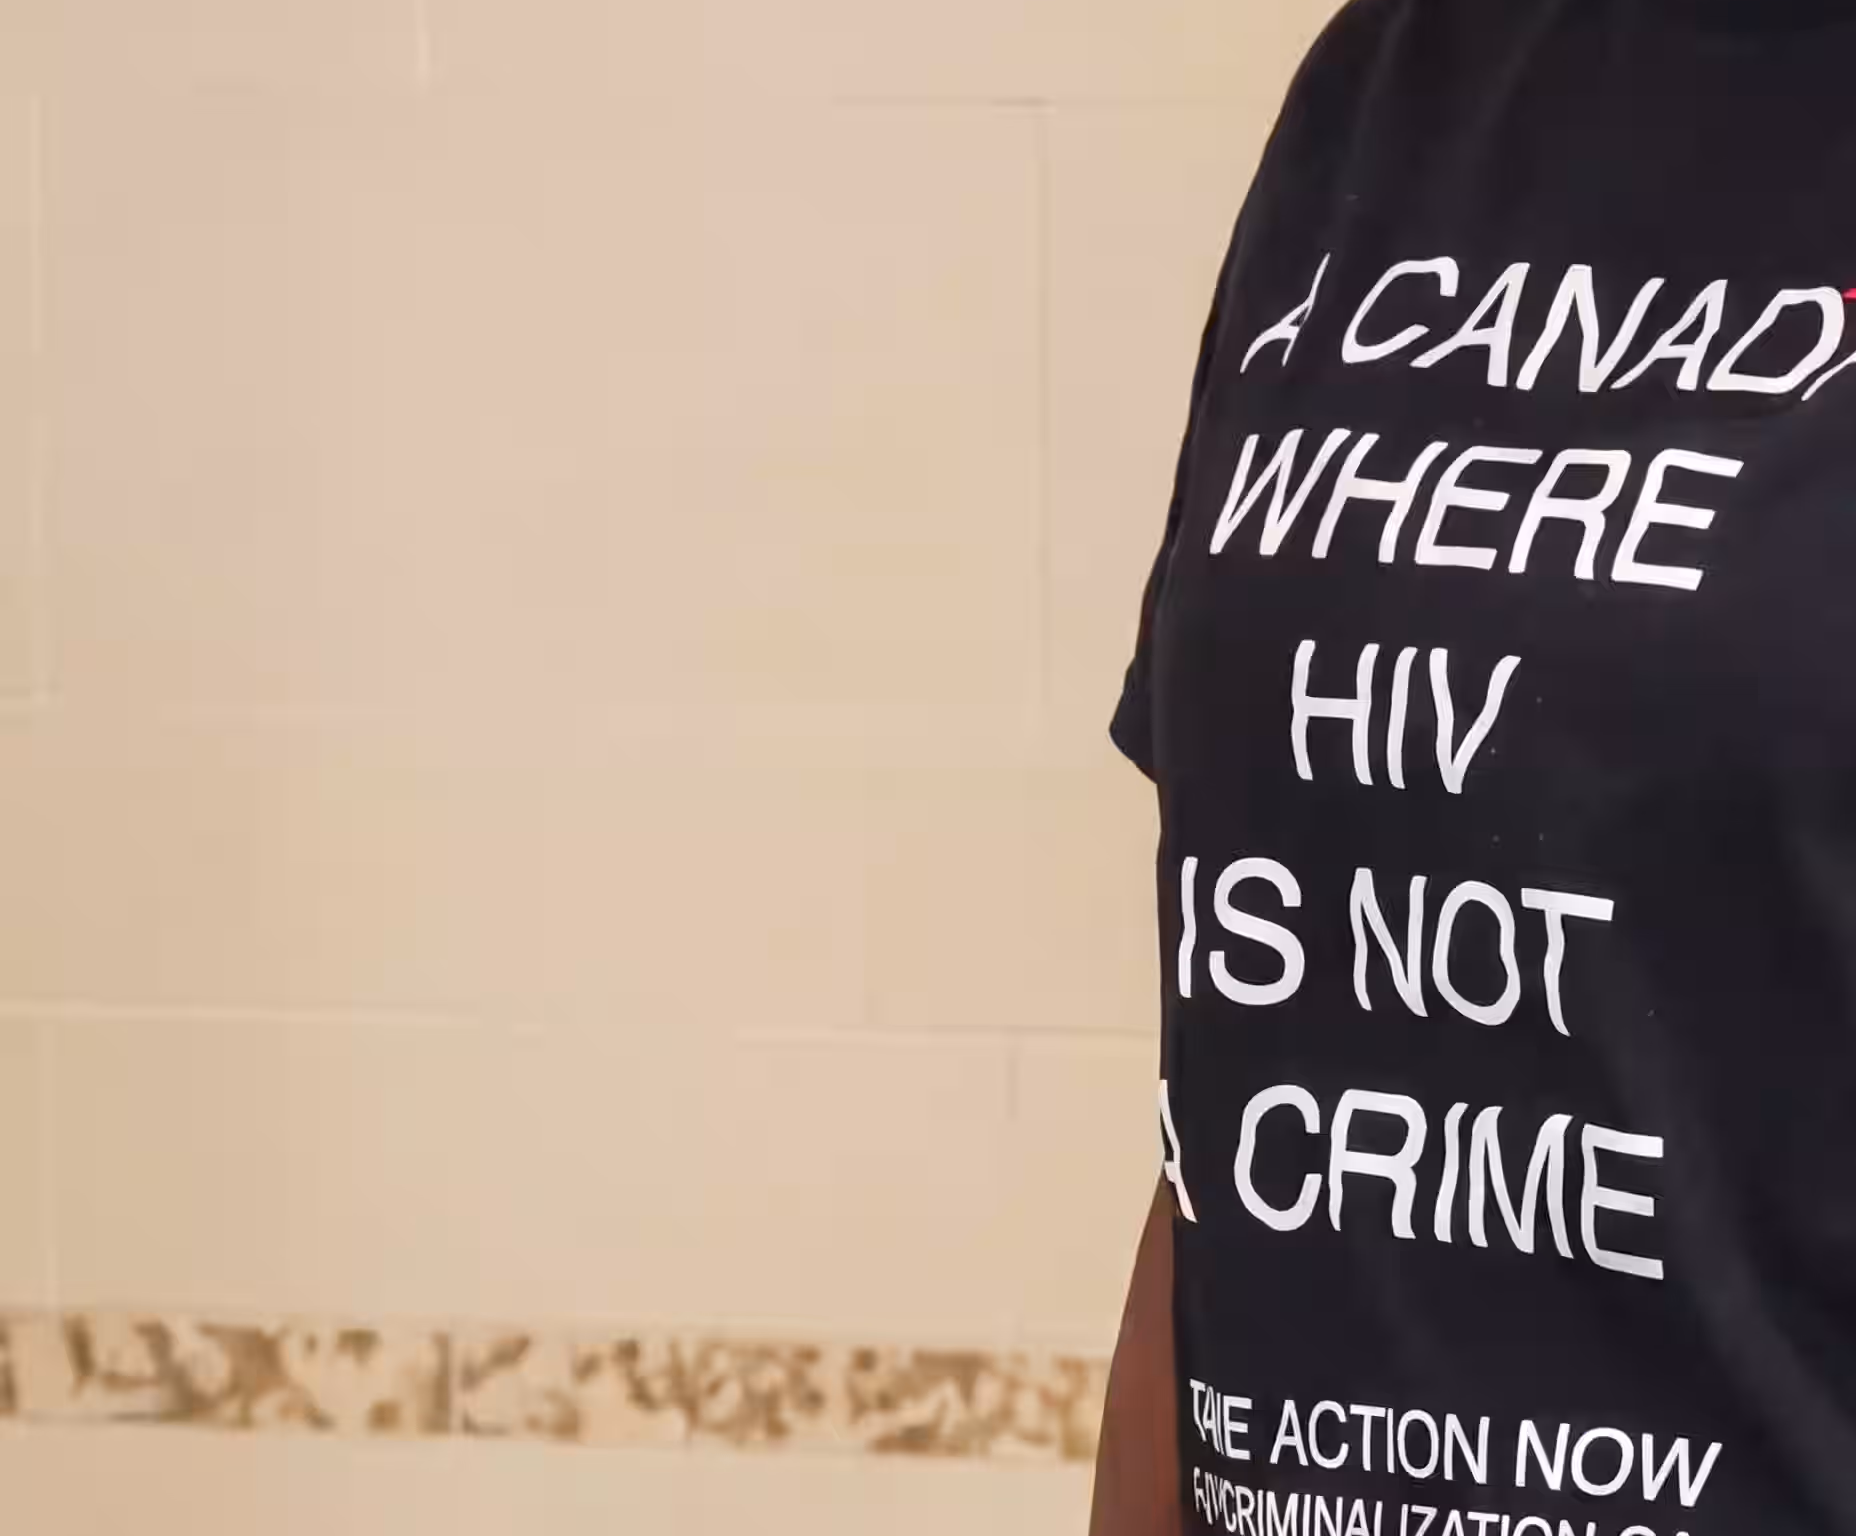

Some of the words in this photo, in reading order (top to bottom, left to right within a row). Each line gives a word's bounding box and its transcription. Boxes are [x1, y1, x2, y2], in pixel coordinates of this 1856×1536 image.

[1240, 252, 1331, 374] A
[1209, 427, 1745, 591] WHERE
[1290, 639, 1522, 796] HIV
[1177, 856, 1306, 1006] IS
[1349, 867, 1615, 1037] NOT
[1233, 1084, 1666, 1281] CRIME
[1269, 1399, 1491, 1485] ACTION
[1515, 1419, 1723, 1508] NOW
